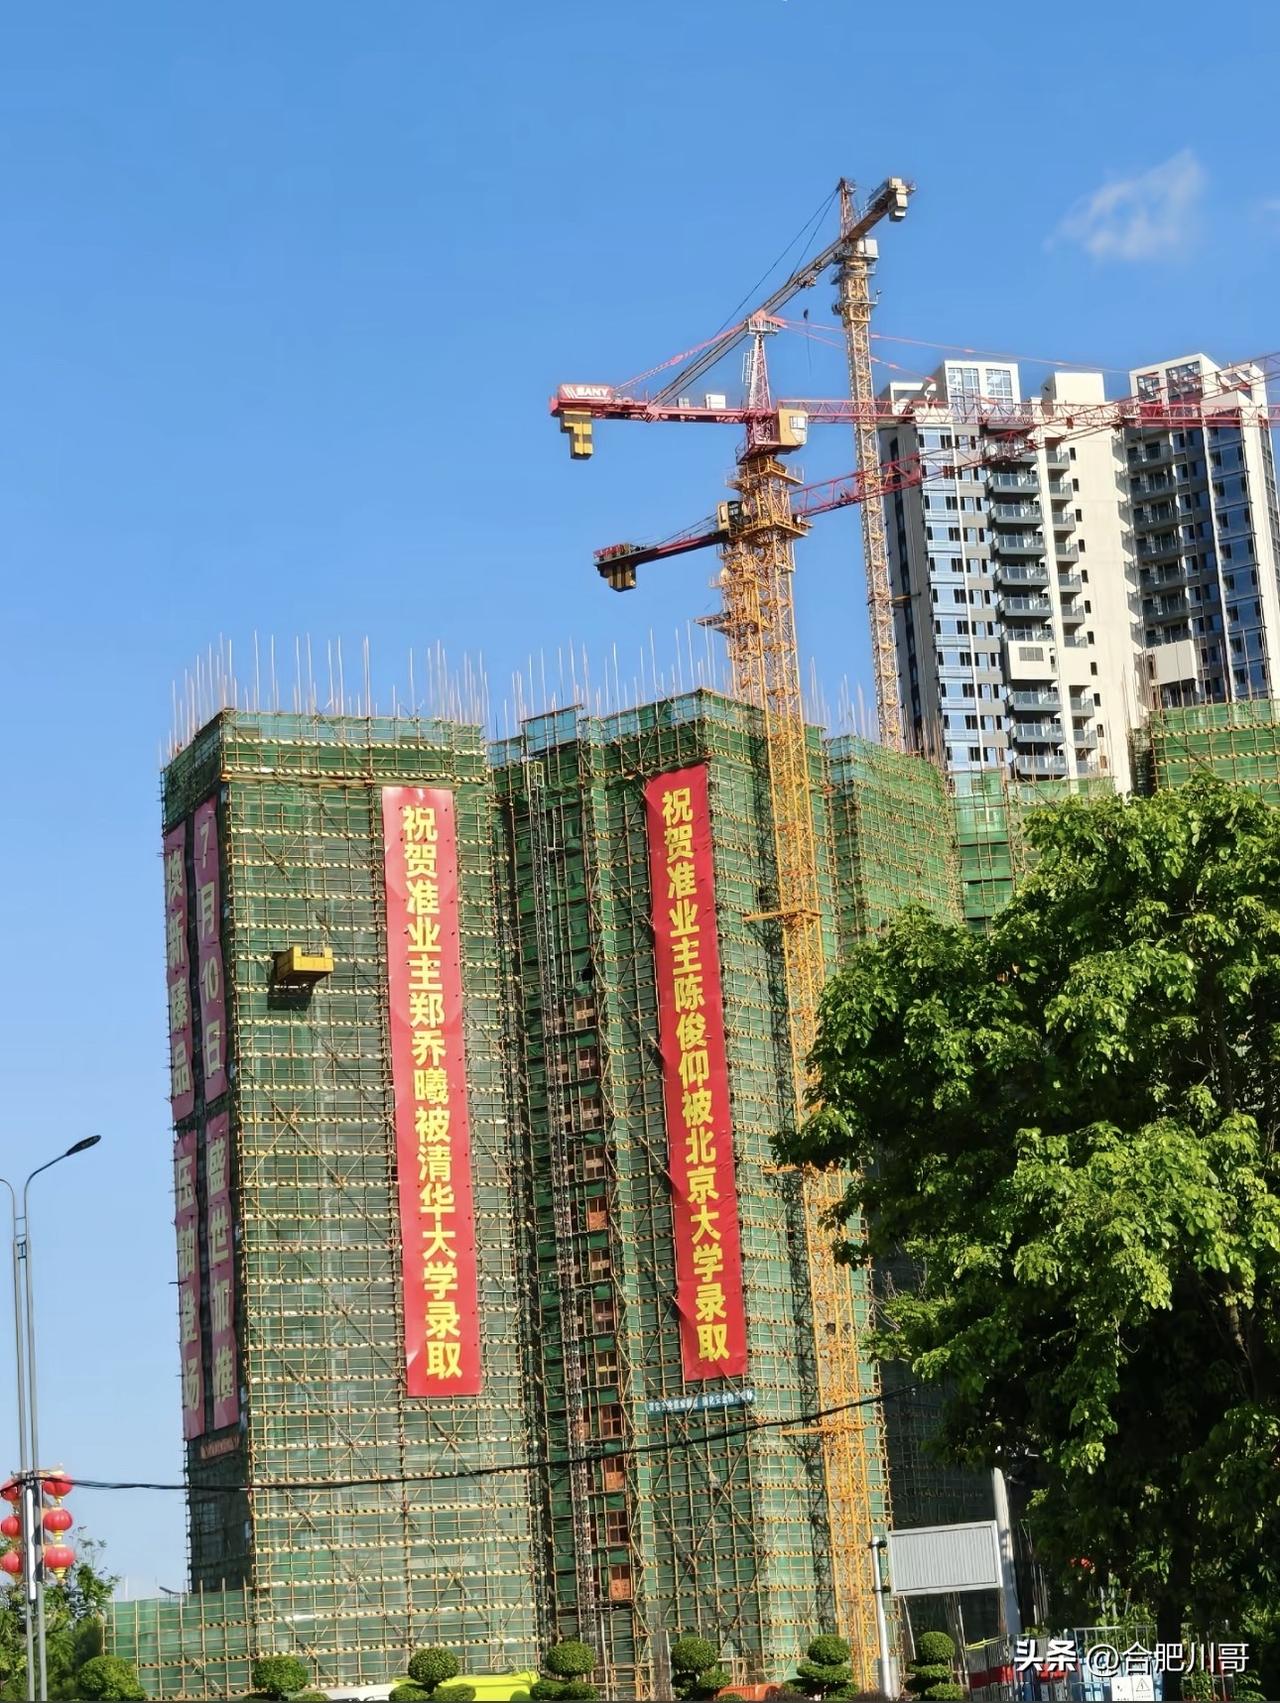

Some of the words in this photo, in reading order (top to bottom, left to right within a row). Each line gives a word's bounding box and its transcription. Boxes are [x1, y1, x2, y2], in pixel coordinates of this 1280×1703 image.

[200, 821, 221, 1077] 7月10日
[402, 805, 463, 1380] 祝贺准业主郑乔曦被清华大学录取
[662, 787, 730, 1363] 祝贺准业主陈俊仰被北京大学录取
